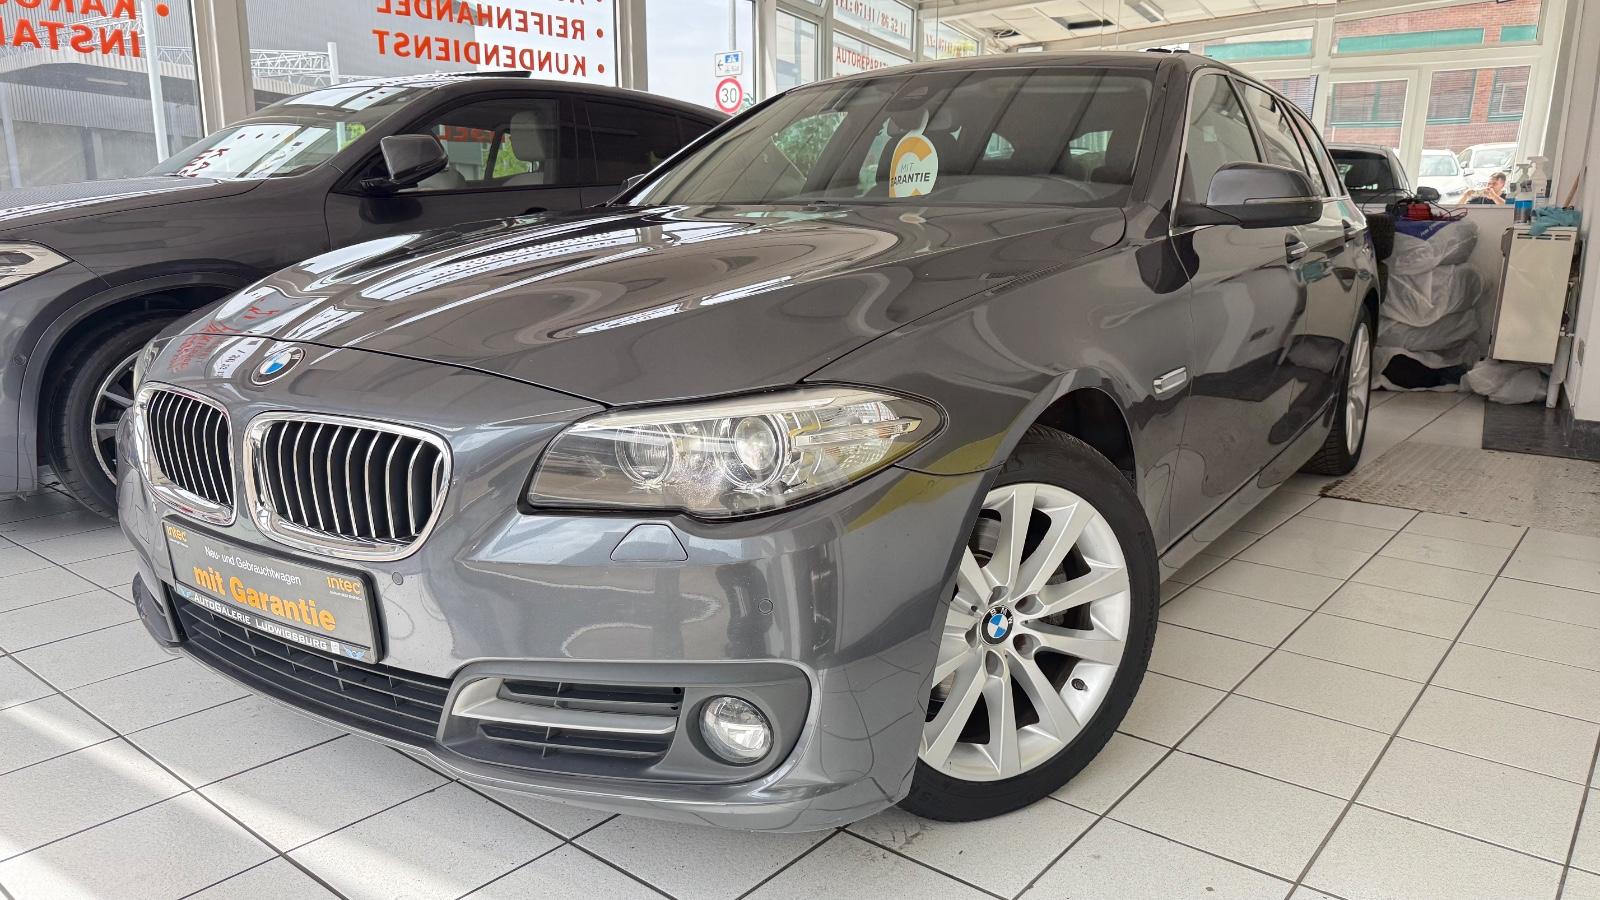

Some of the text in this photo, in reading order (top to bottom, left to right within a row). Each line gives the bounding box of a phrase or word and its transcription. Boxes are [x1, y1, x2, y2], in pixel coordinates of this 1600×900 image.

[721, 87, 737, 103] 30
[901, 162, 915, 173] MIT
[221, 553, 236, 567] und
[235, 556, 302, 586] Gebrauchtwagen
[327, 575, 362, 595] intec
[192, 565, 336, 632] mit Garantie
